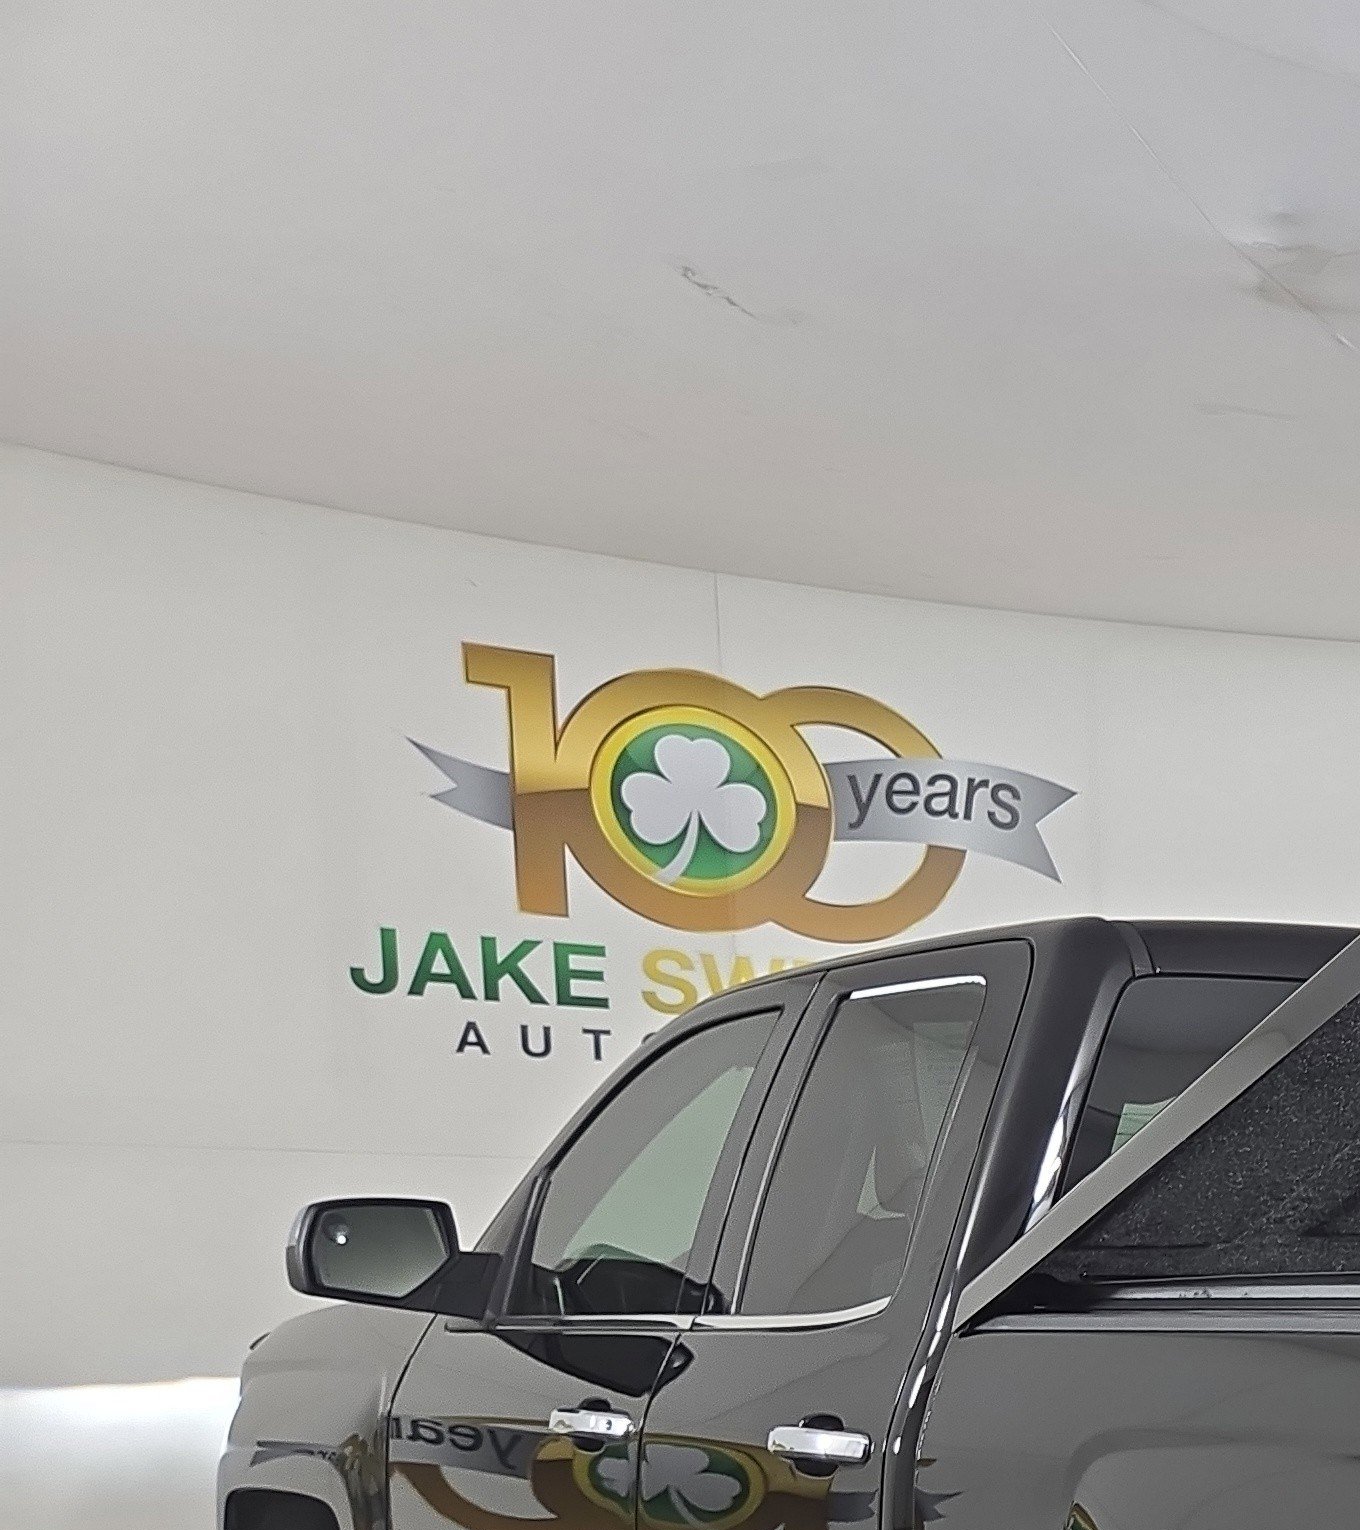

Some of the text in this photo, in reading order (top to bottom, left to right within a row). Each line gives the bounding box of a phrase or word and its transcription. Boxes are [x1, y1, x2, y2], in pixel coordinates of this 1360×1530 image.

[846, 765, 1023, 831] years
[349, 926, 610, 1010] JAKE
[456, 1020, 655, 1061] AUT
